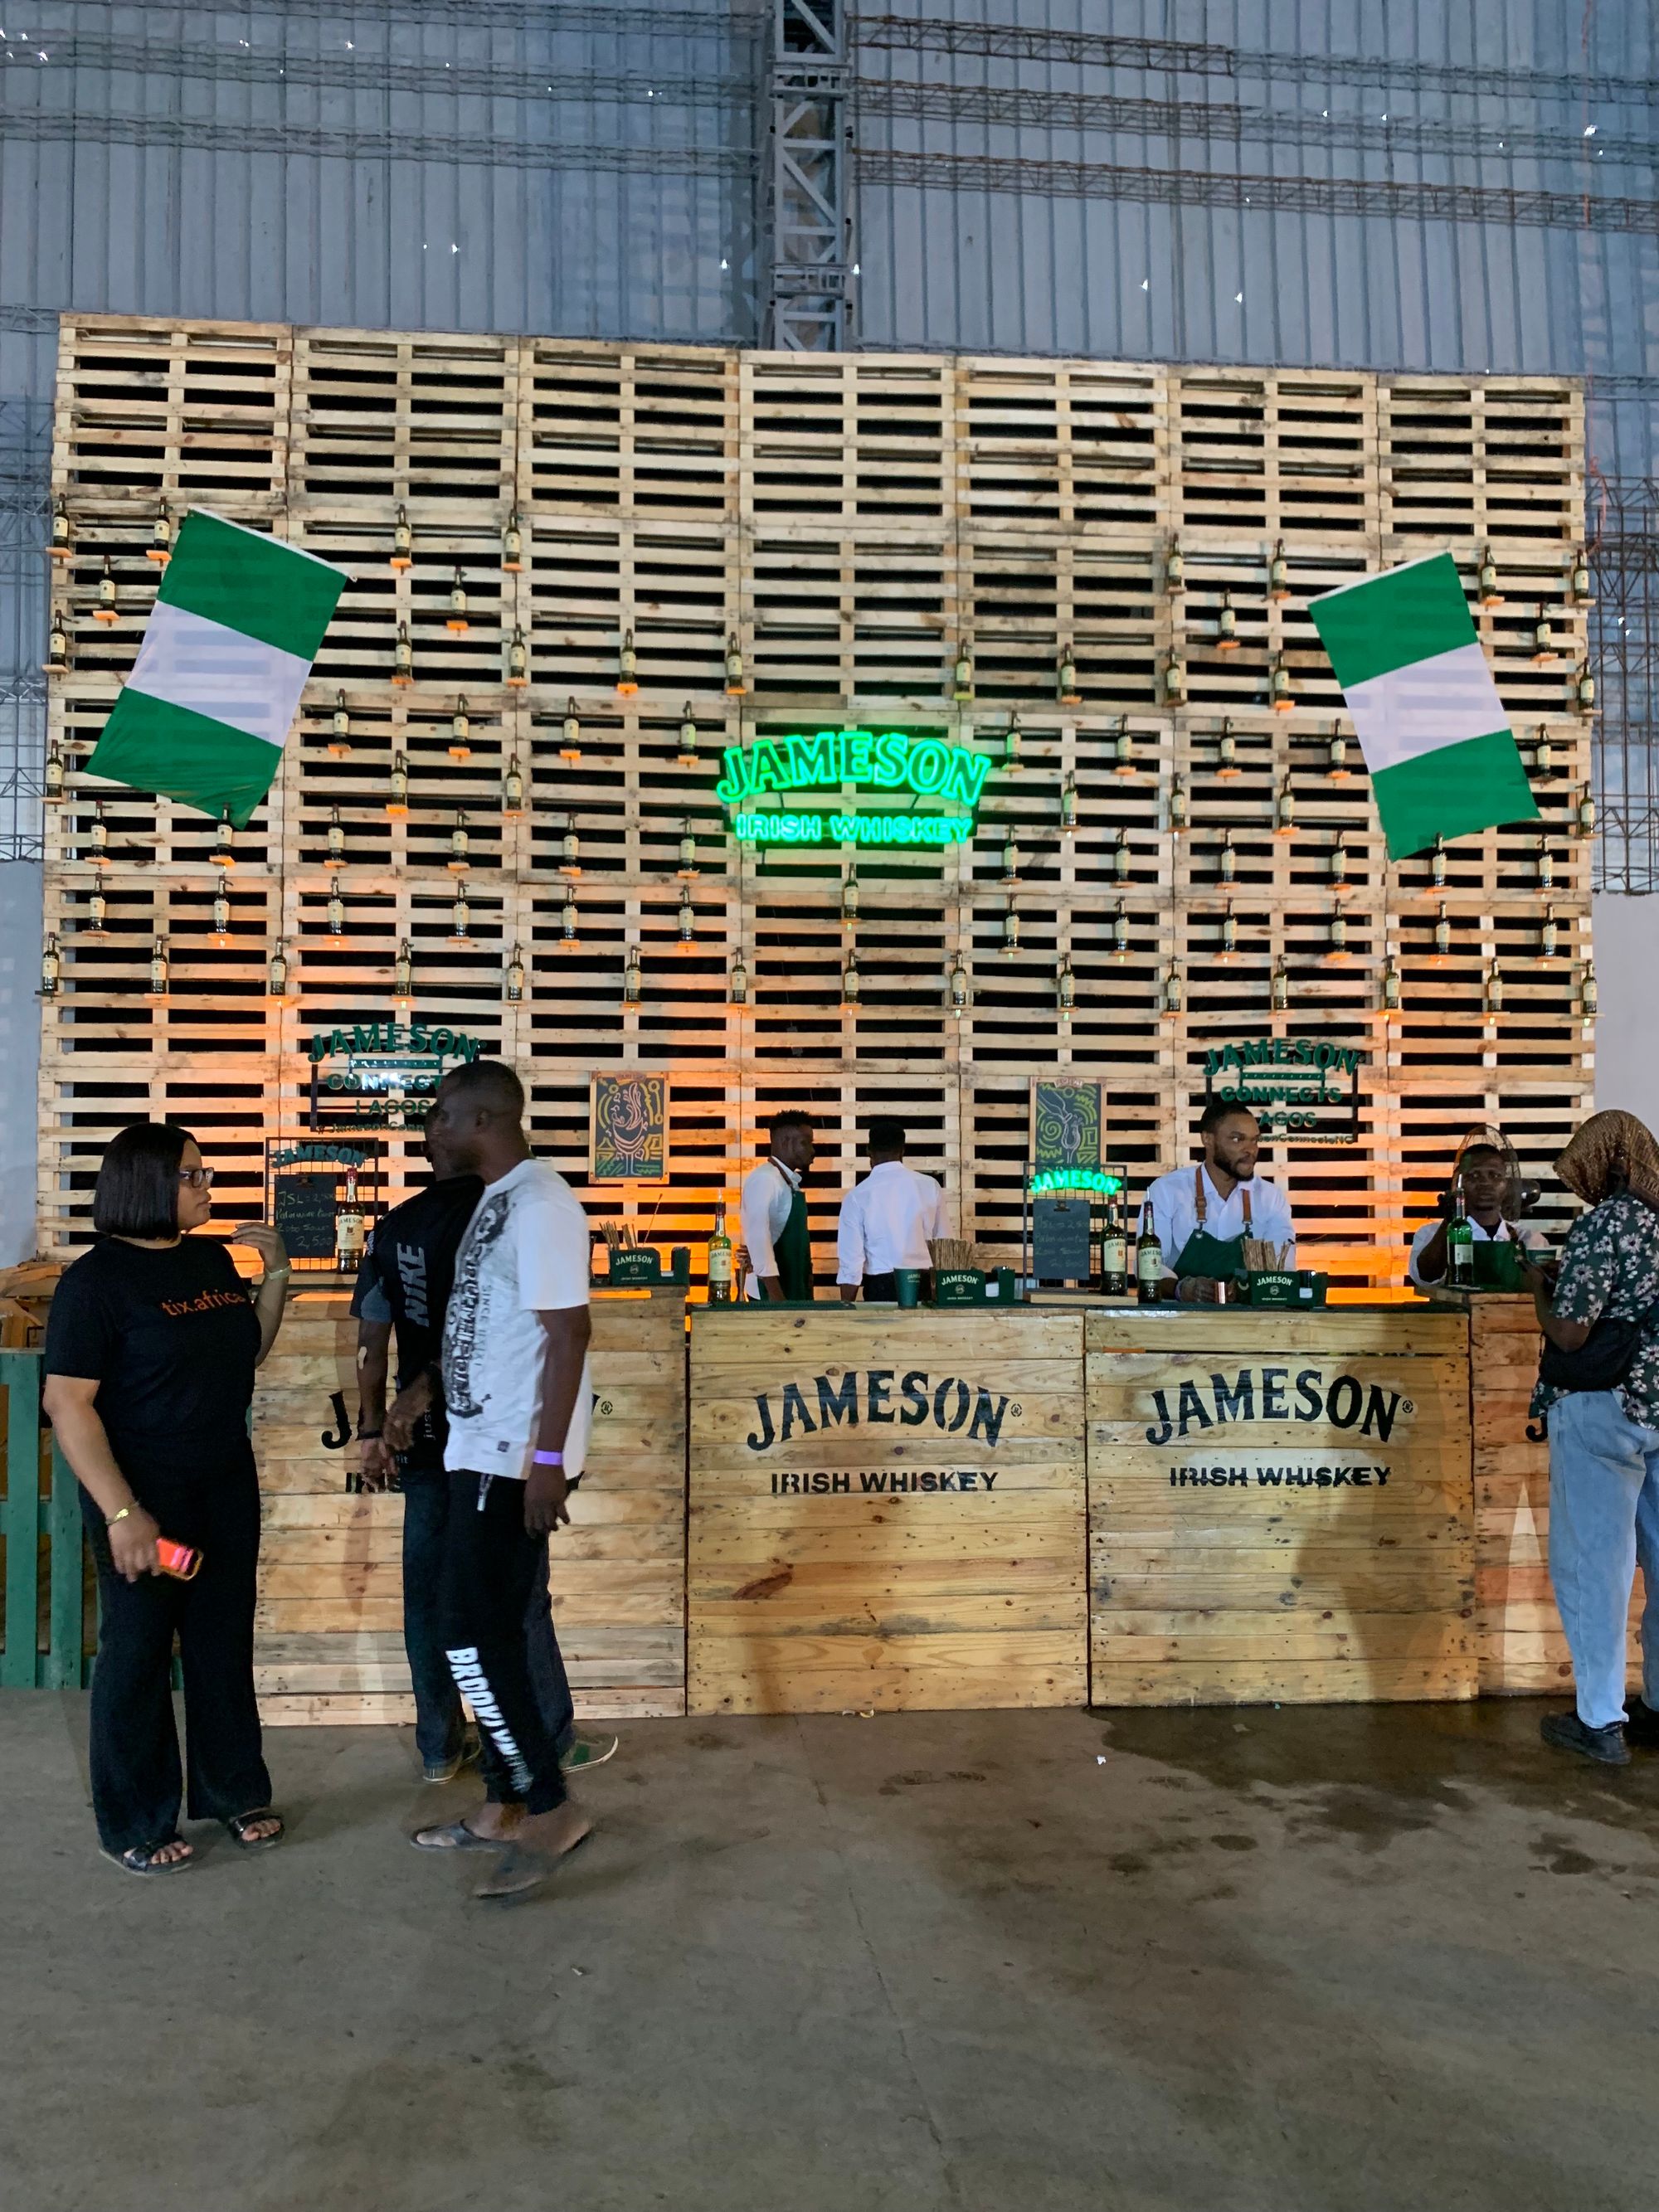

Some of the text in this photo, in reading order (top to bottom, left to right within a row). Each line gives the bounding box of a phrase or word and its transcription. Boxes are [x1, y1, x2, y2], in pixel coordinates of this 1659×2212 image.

[717, 732, 991, 806] JAMESON
[736, 814, 973, 843] IRISH WHISKEY
[308, 1022, 480, 1063] JAMESON
[1203, 1038, 1359, 1076] JAMESON
[327, 1072, 446, 1090] CONNECT
[1220, 1086, 1342, 1103] CONNECTS
[1258, 1111, 1317, 1128] AGOS
[272, 1145, 367, 1168] JAMESON
[1031, 1170, 1121, 1195] JAMESON
[615, 1255, 653, 1266] JAMESON
[397, 1242, 429, 1327] NIKE
[941, 1274, 977, 1286] JAMESON
[1257, 1276, 1292, 1286] JAMESON
[162, 1289, 246, 1315] tix.africa
[771, 1471, 998, 1493] IRISH WHISKEY
[1170, 1466, 1391, 1489] IRISH WHISKEY
